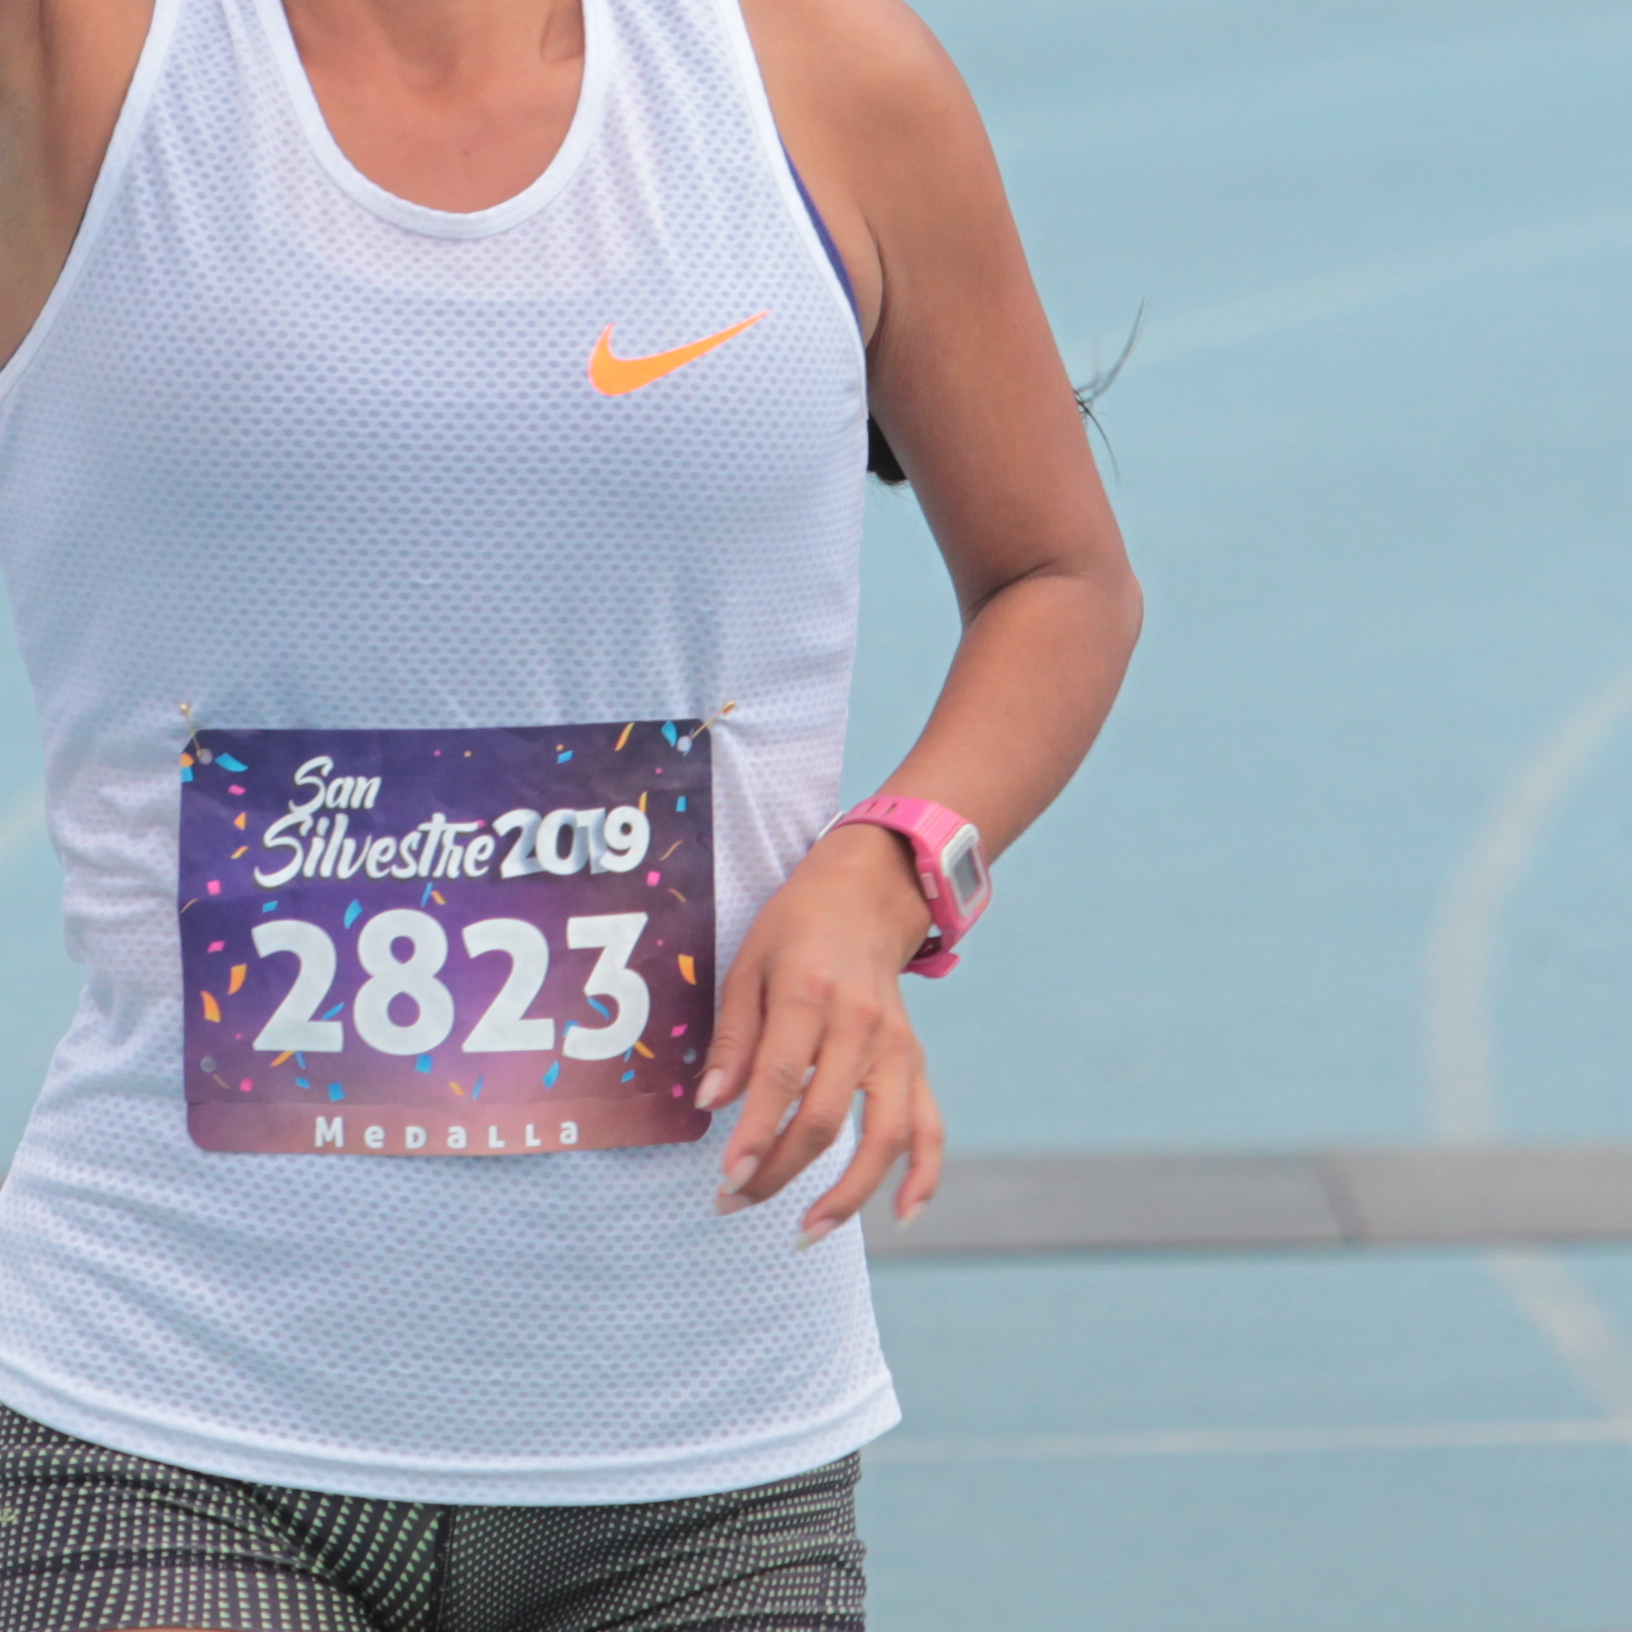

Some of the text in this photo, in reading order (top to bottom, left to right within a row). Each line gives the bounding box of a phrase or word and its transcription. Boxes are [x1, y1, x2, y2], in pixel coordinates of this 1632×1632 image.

[288, 756, 382, 815] San
[254, 805, 651, 888] Silvestre 2019
[251, 909, 651, 1061] 2823
